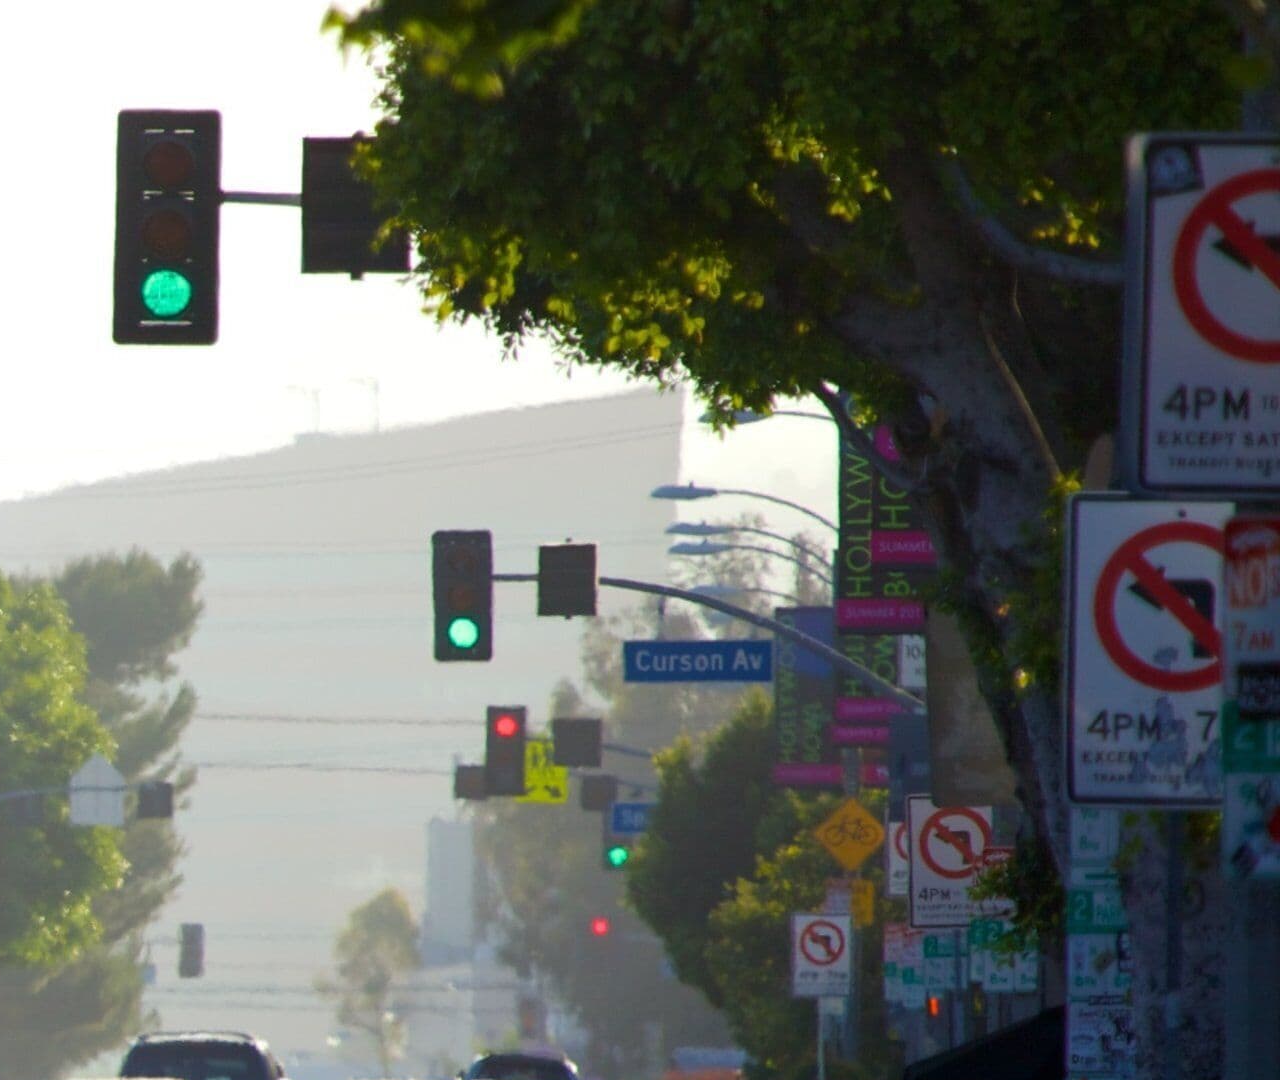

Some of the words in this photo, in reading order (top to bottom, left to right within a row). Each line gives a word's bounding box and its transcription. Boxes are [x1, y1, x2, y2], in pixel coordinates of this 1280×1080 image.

[1162, 384, 1251, 421] 4PM
[1156, 431, 1235, 448] EXCEPT
[635, 650, 723, 672] Curson
[732, 648, 763, 671] Av
[1087, 710, 1162, 742] 4PM
[918, 888, 951, 901] 4PM
